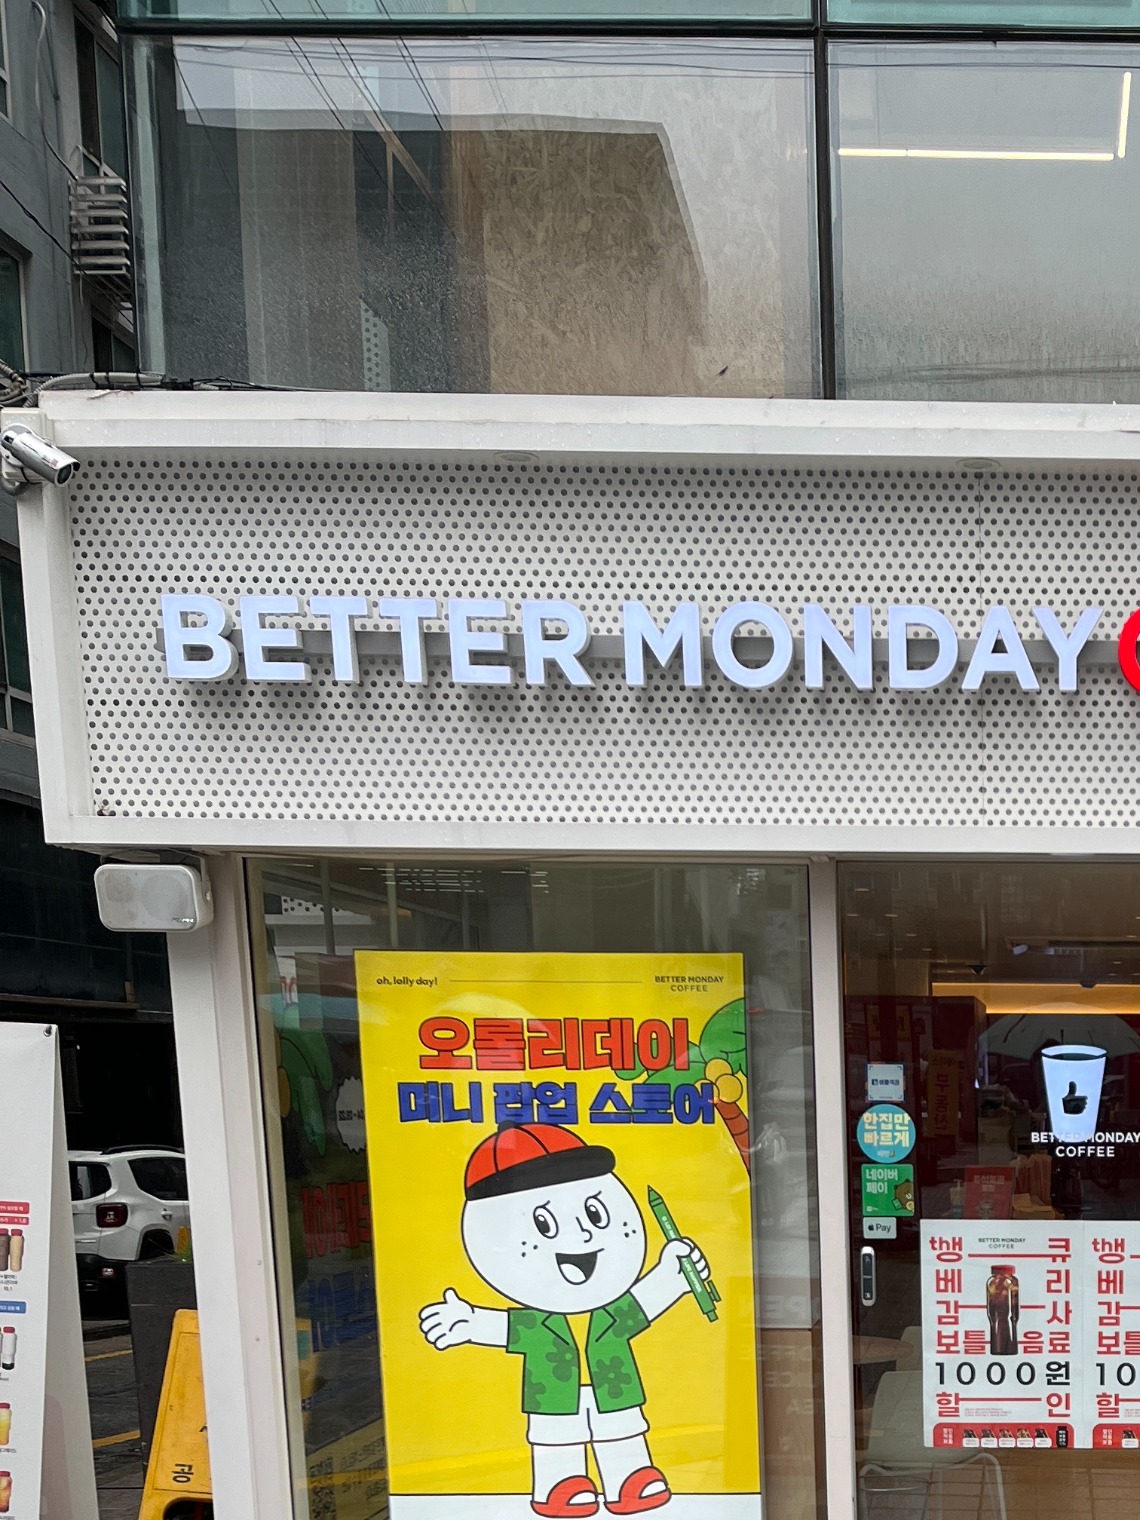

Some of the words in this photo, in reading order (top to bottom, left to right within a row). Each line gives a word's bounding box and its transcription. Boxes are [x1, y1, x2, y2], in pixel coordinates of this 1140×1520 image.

[160, 592, 597, 689] BETTER
[621, 599, 1105, 694] MONDAY
[416, 976, 438, 988] day!
[654, 975, 687, 984] BETTER
[688, 975, 725, 984] MONDAY
[670, 984, 708, 993] COFFEE
[418, 1016, 691, 1071] 오롤리데이
[397, 1081, 484, 1124] 미니
[493, 1081, 580, 1125] 팝업
[589, 1081, 715, 1125] 스토어
[863, 1111, 911, 1131] 한집만
[863, 1130, 910, 1149] 빠르게
[1055, 1145, 1115, 1157] COFFEE
[866, 1168, 899, 1181] 네이버
[866, 1181, 889, 1195] 페이
[875, 1223, 892, 1233] Pay
[936, 1330, 987, 1355] 보틀
[1021, 1330, 1071, 1355] 음료
